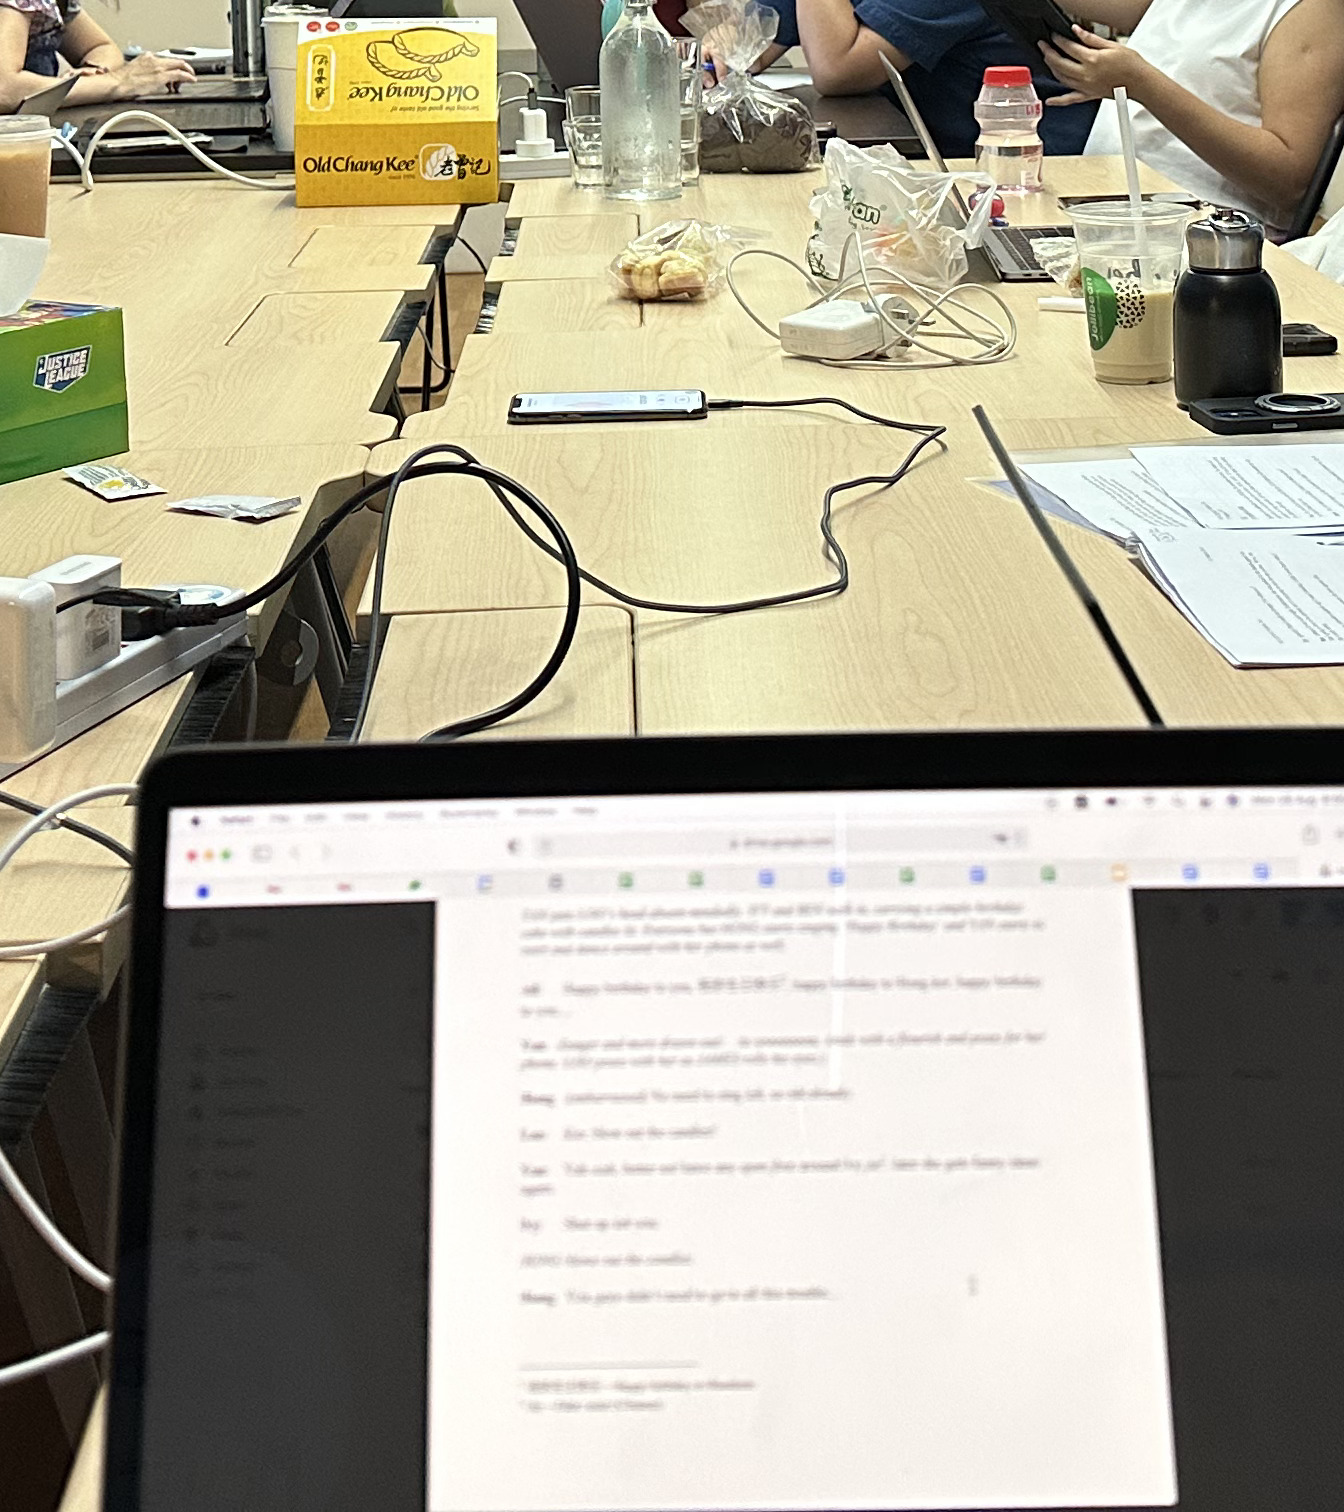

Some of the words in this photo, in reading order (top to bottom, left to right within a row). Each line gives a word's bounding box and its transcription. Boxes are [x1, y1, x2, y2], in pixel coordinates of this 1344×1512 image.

[348, 85, 384, 103] Kee
[386, 82, 446, 104] Chang
[446, 84, 480, 103] Old
[302, 155, 332, 173] Old
[332, 154, 384, 176] Chang
[385, 156, 416, 172] Kee
[38, 349, 88, 375] JUSTICE
[44, 364, 86, 390] LEAGUE
